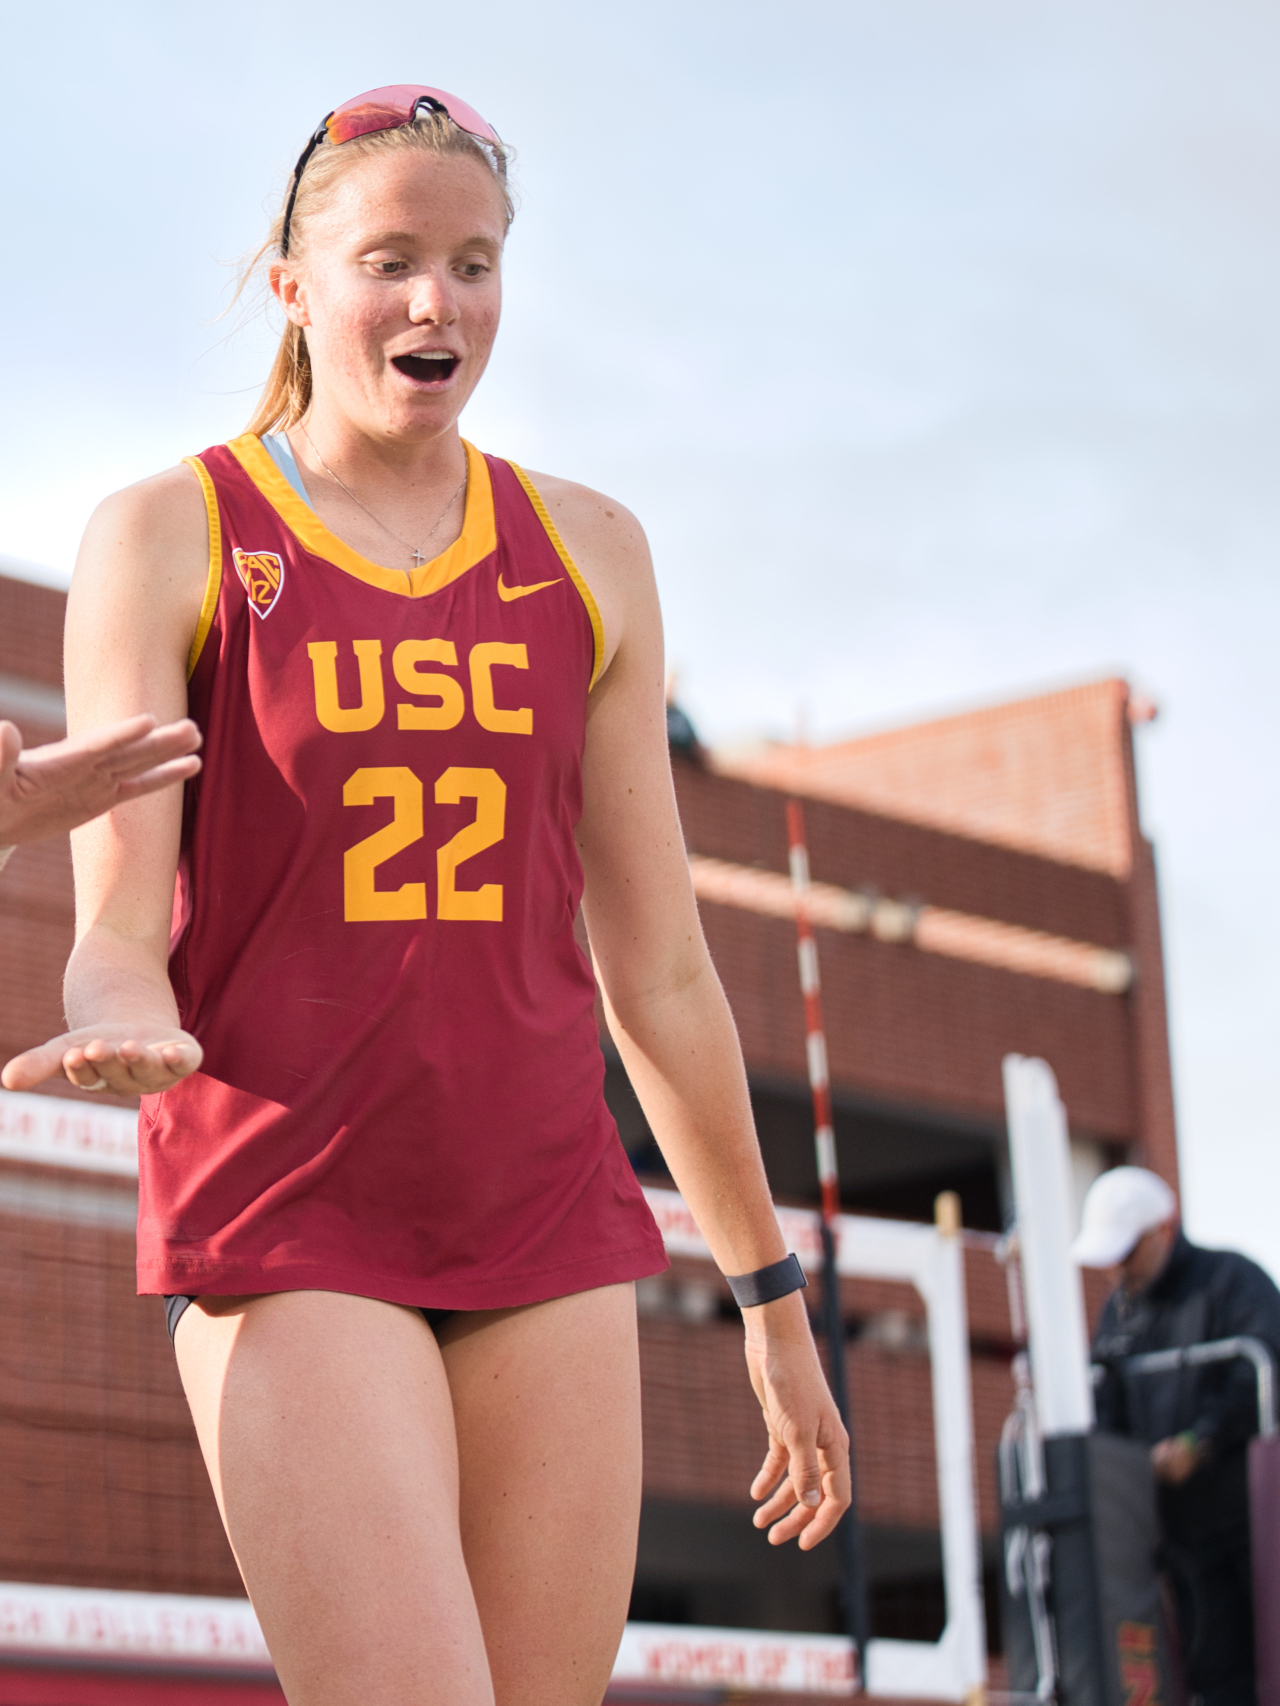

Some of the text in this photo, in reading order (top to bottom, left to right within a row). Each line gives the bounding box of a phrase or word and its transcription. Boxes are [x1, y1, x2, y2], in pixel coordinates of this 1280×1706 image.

[234, 551, 280, 591] PAC
[250, 578, 273, 604] 12
[306, 637, 534, 735] USC
[342, 766, 508, 923] 22
